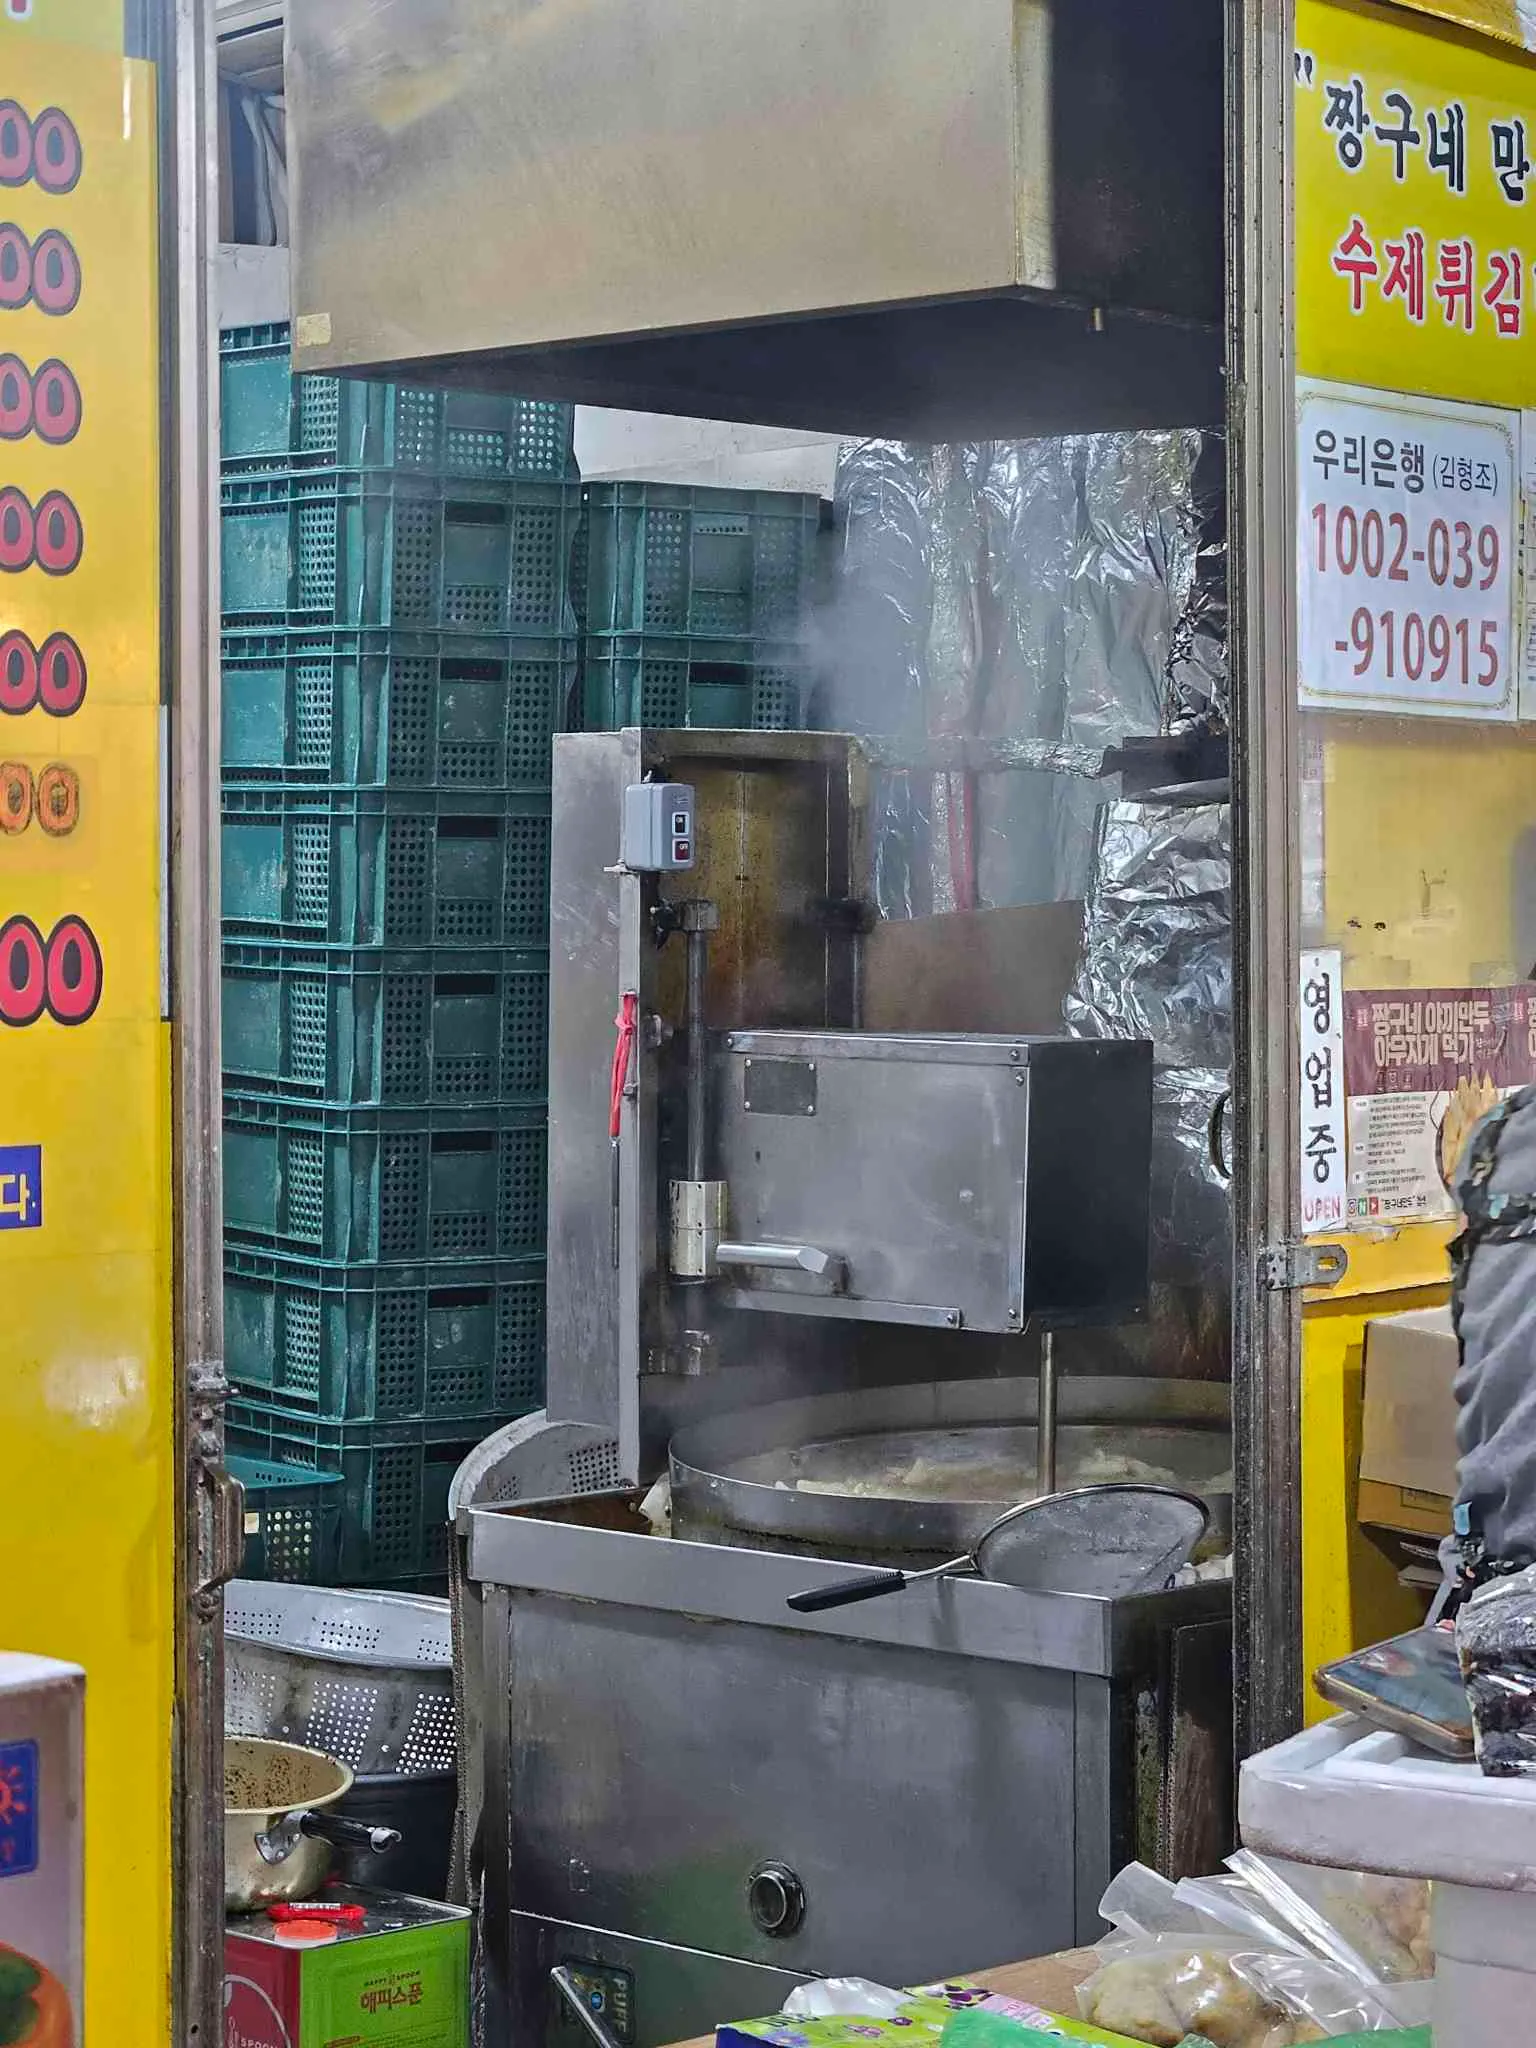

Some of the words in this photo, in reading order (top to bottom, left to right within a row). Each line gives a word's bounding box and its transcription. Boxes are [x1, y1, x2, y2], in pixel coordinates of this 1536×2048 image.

[1312, 429, 1425, 494] 우리은행
[1432, 453, 1499, 497] (김형조)
[1311, 502, 1499, 591] 1002-039
[1335, 606, 1499, 687] -910915
[1371, 1000, 1422, 1036] 짱구네
[1303, 972, 1337, 1184] 영업중
[240, 2037, 278, 2048] SPOO
